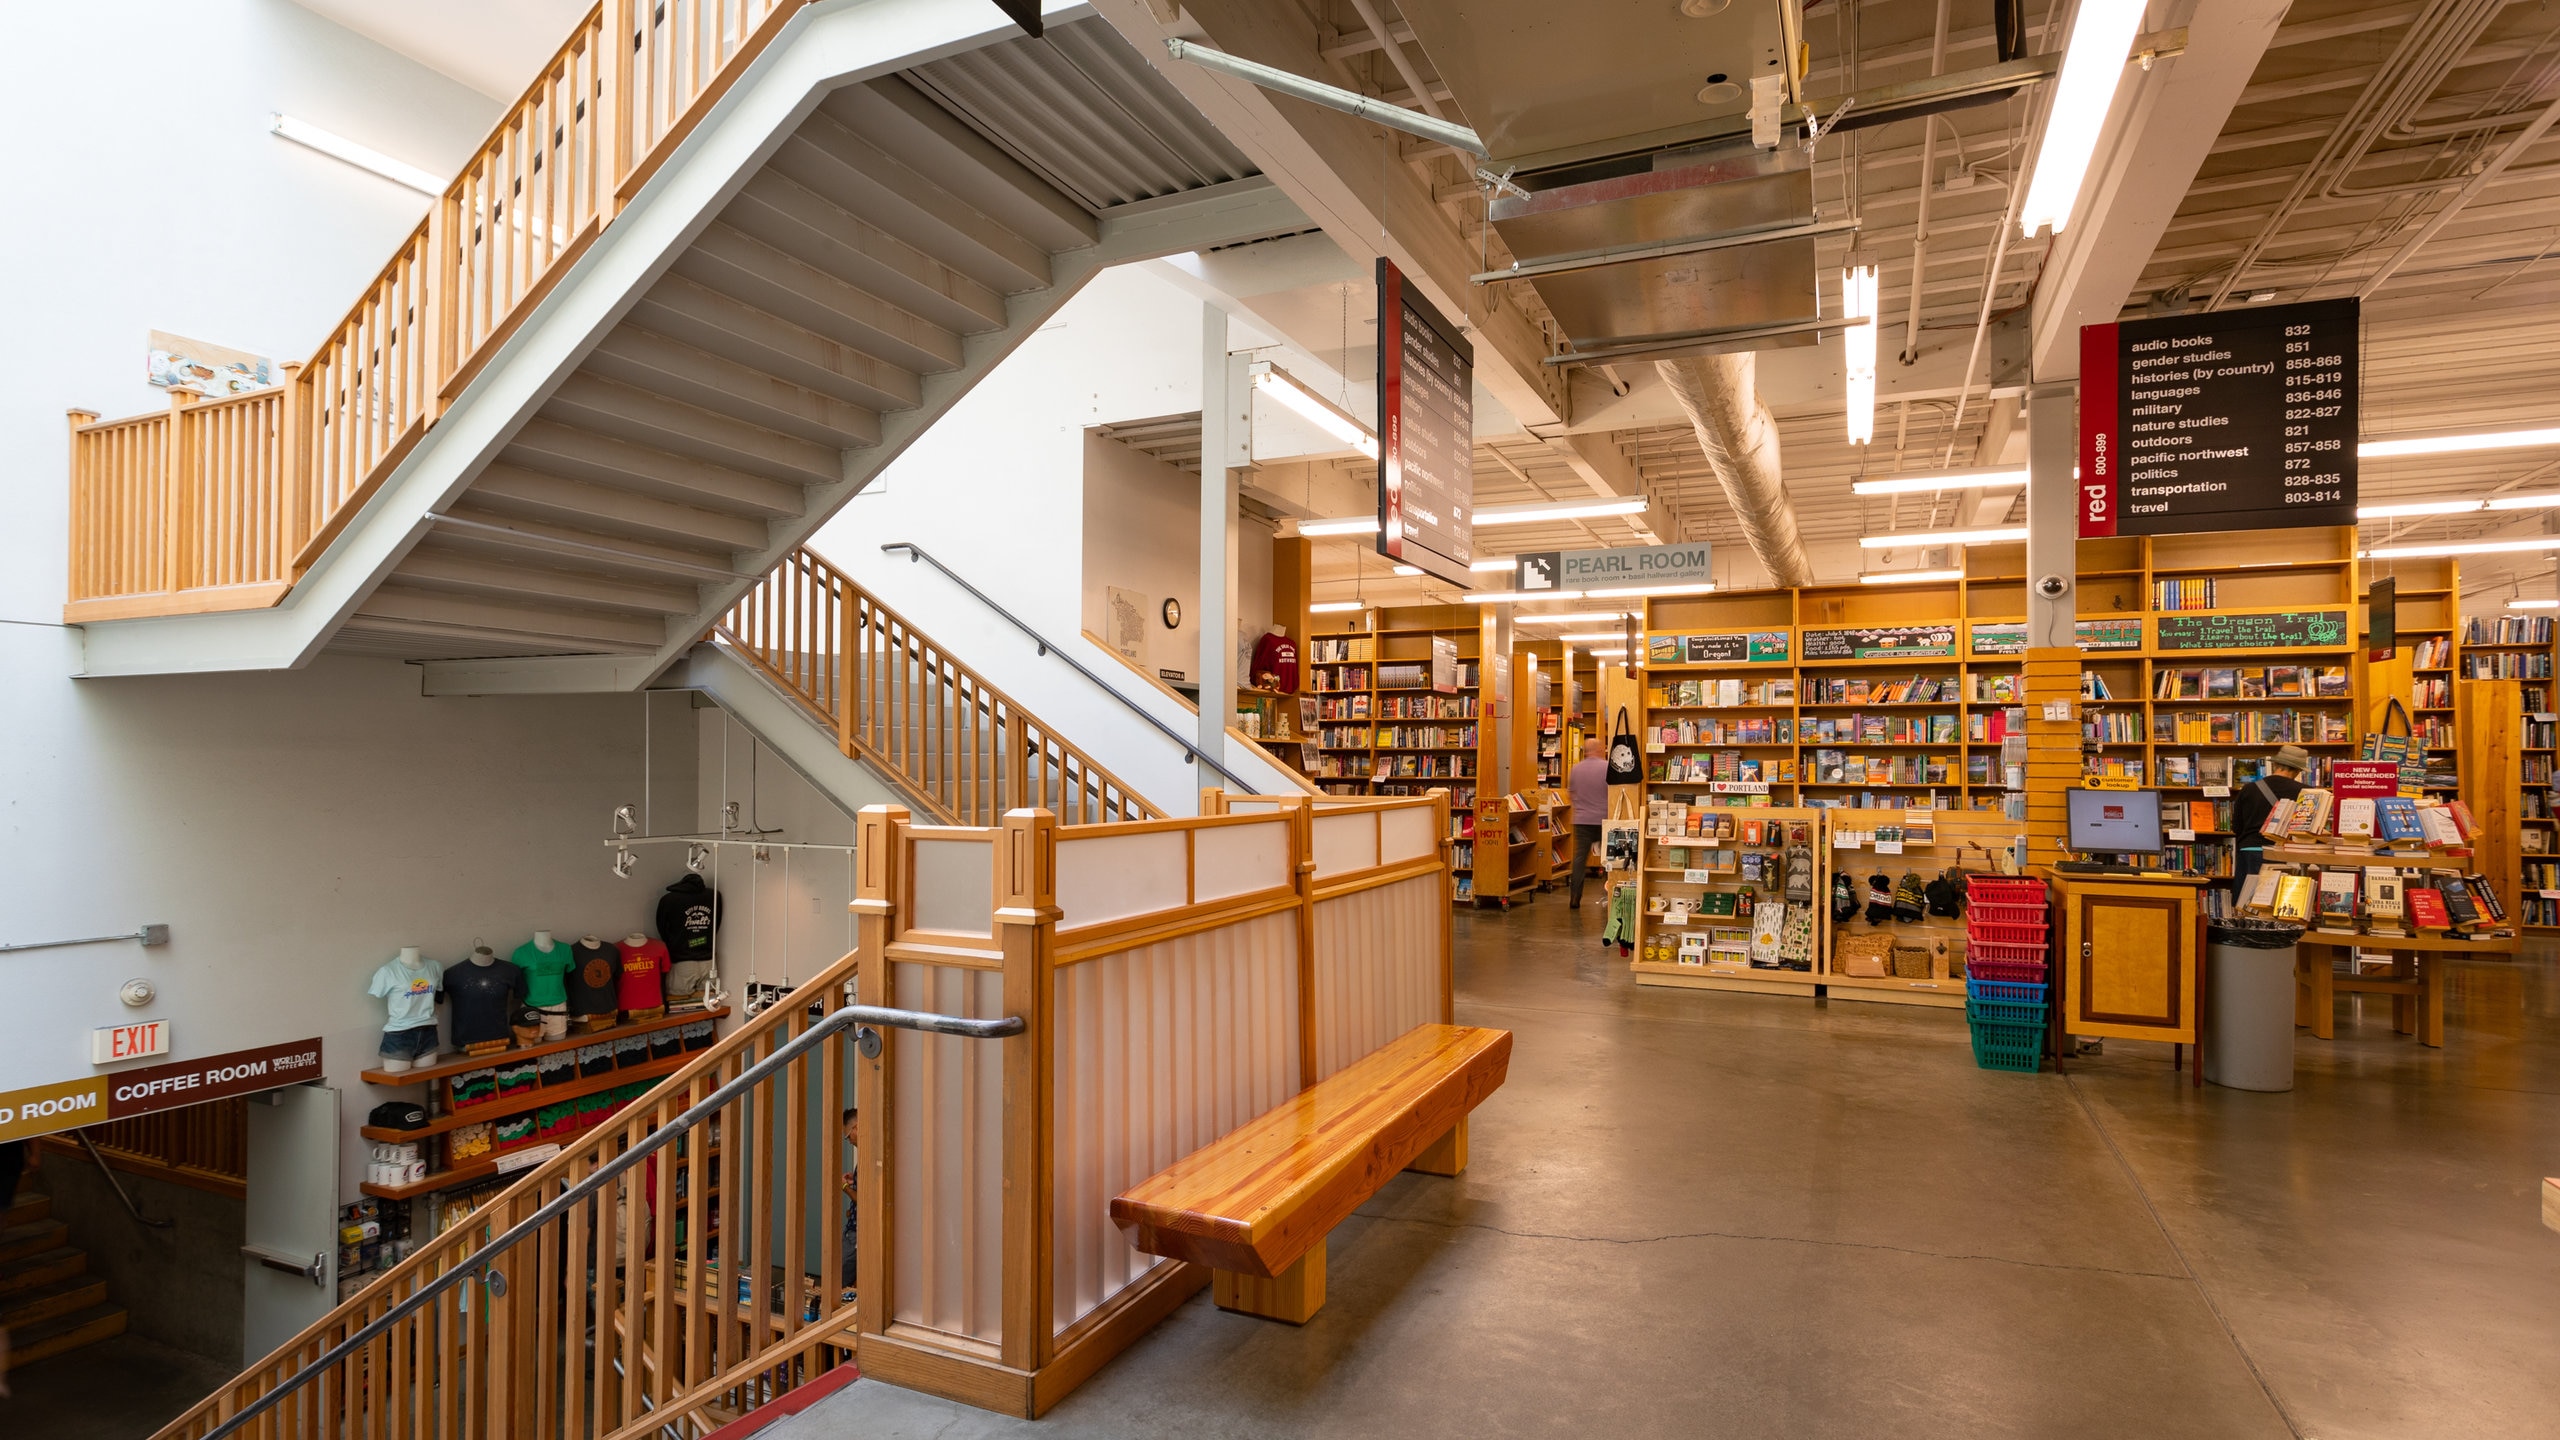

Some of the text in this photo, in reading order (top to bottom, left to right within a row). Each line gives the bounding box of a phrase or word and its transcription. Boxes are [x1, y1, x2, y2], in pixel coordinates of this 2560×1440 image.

[1403, 311, 1418, 330] audio
[1418, 324, 1433, 344] books
[2132, 325, 2311, 352] audio books 832
[1403, 331, 1423, 350] gender
[1422, 347, 1440, 368] studies
[2132, 342, 2310, 371] gender studies 851
[2131, 355, 2342, 385] histories (by country) 858-868
[2131, 372, 2342, 401] languages 815-819
[2132, 389, 2342, 417] military 836-846
[2132, 406, 2342, 433] nature studies 822-827
[2132, 425, 2310, 449] outdoors 821
[2131, 440, 2341, 466] pacific northwest 857-858
[1404, 458, 1421, 478] pacific
[2084, 433, 2107, 522] red 800-899
[2131, 459, 2311, 483] politics 872
[2131, 473, 2341, 497] transportation 828-835
[2131, 490, 2342, 513] travel 803-814
[1404, 501, 1439, 527] transportation
[1404, 522, 1420, 538] travel
[1566, 551, 1705, 575] PEARL ROOM
[1647, 571, 1678, 579] hallward
[1680, 571, 1705, 579] gallery
[2173, 612, 2324, 627] The Oregon Trail
[2237, 626, 2252, 634] the
[2254, 625, 2276, 633] trail
[2160, 629, 2173, 638] You
[2180, 641, 2202, 649] What
[2239, 640, 2275, 648] choice?
[2233, 633, 2260, 641] about
[2262, 632, 2278, 640] the
[2280, 632, 2303, 640] trail
[1703, 649, 1731, 660] Oregon!
[1161, 670, 1181, 678] ELEVATOR
[1712, 782, 1770, 793] I PORTLAND
[1480, 830, 1503, 839] HOYT
[624, 960, 655, 972] POWELL'S
[112, 1023, 160, 1059] EXIT
[272, 1051, 317, 1067] WORLD CUP
[273, 1062, 298, 1072] COFFEE
[115, 1060, 268, 1102] COFFEE ROOM
[21, 1091, 97, 1121] ROOM
